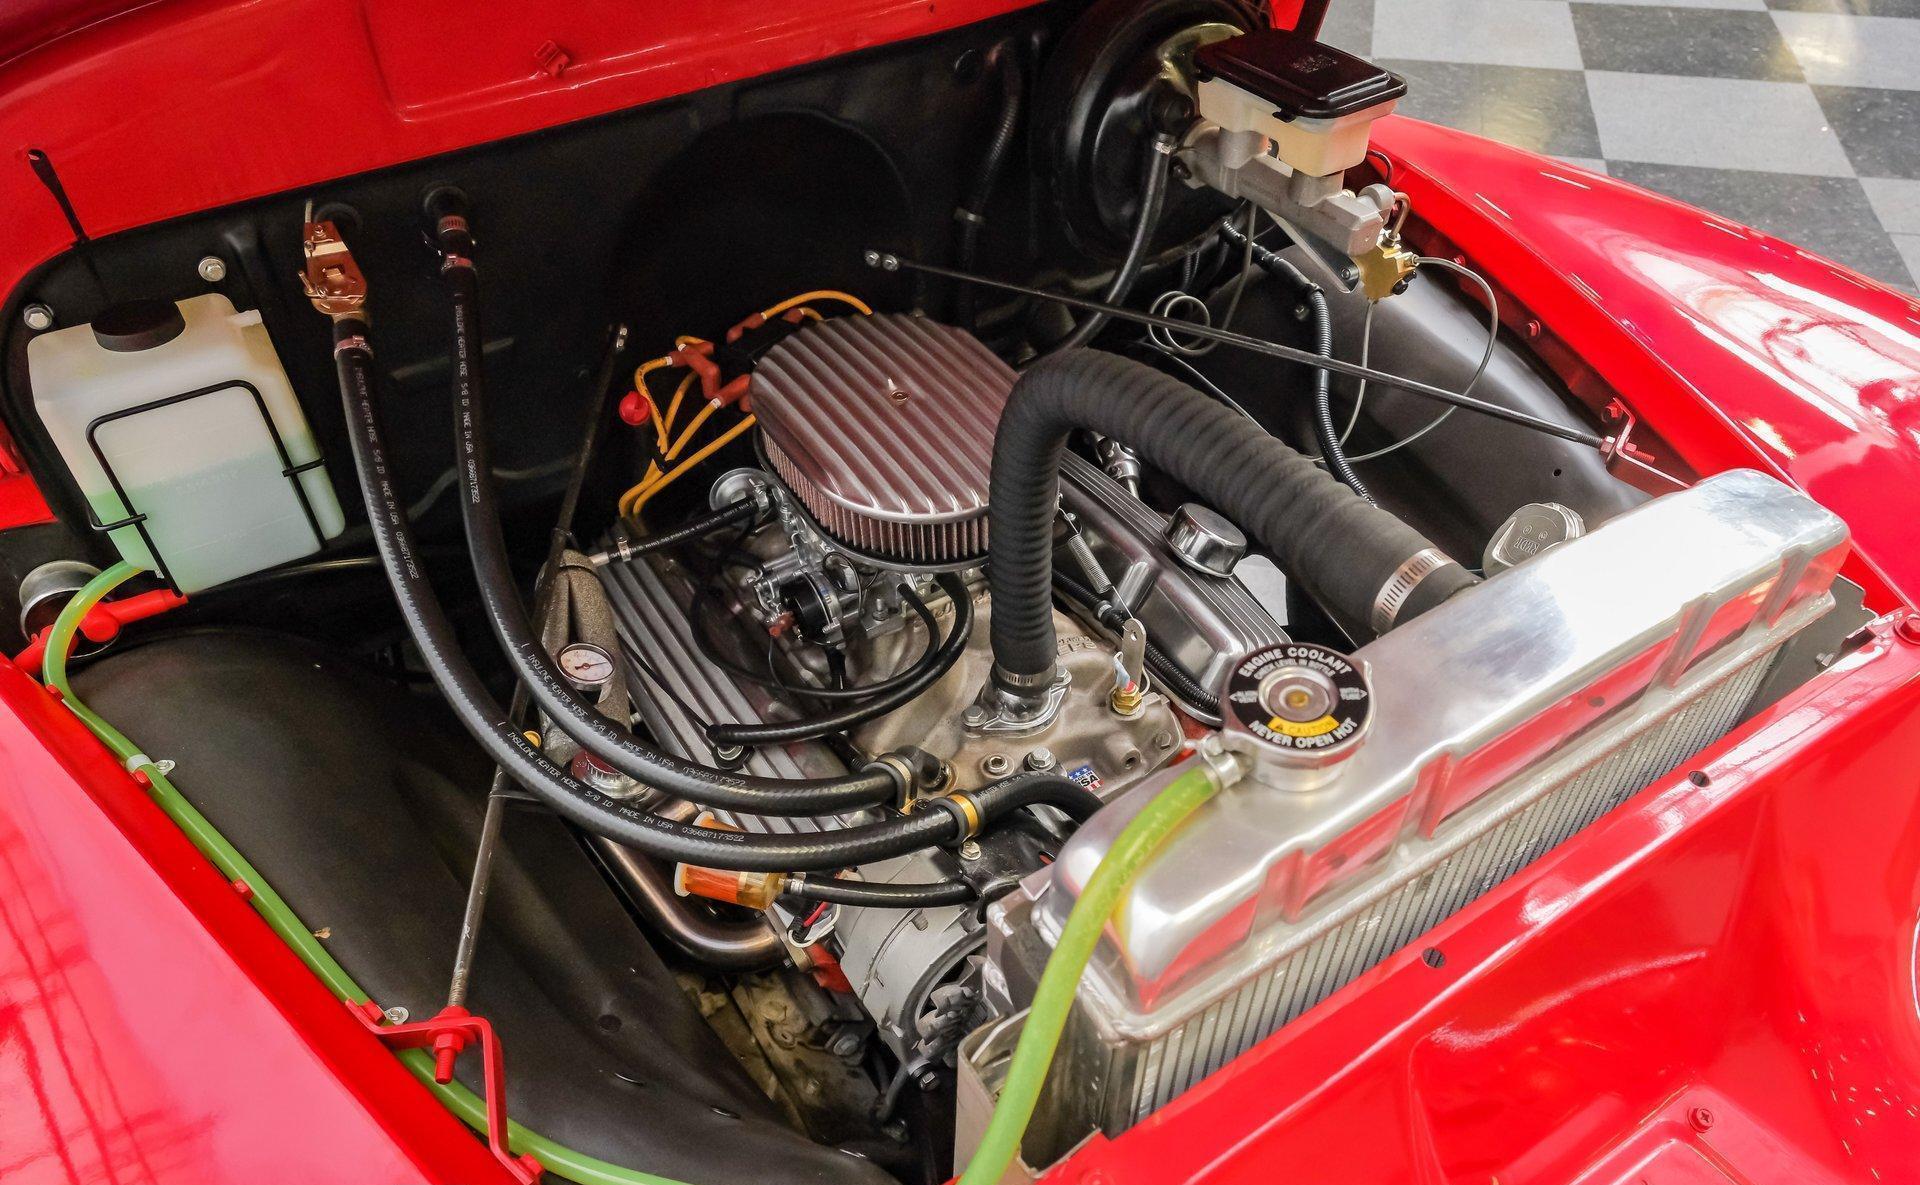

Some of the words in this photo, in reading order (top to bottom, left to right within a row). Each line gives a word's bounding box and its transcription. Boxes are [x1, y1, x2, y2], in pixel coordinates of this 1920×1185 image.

[462, 411, 472, 429] MADE
[465, 441, 474, 454] USA
[379, 480, 392, 498] MADE
[386, 501, 396, 510] IN
[389, 512, 400, 526] USA
[1238, 648, 1284, 677] ENGINE
[1287, 647, 1352, 674] COOLANT
[551, 682, 572, 703] HEATER
[607, 730, 618, 740] ID
[622, 740, 643, 753] MADE
[645, 751, 657, 760] IN
[1248, 720, 1293, 746] NEVER
[1295, 733, 1335, 748] OPEN
[1332, 717, 1358, 740] HOT
[1078, 775, 1099, 788] SA
[535, 757, 561, 778] HEATER
[560, 776, 581, 790] HOSE
[602, 800, 614, 808] ID
[618, 807, 640, 820] MADE
[643, 816, 655, 824] IN
[657, 820, 674, 830] USA
